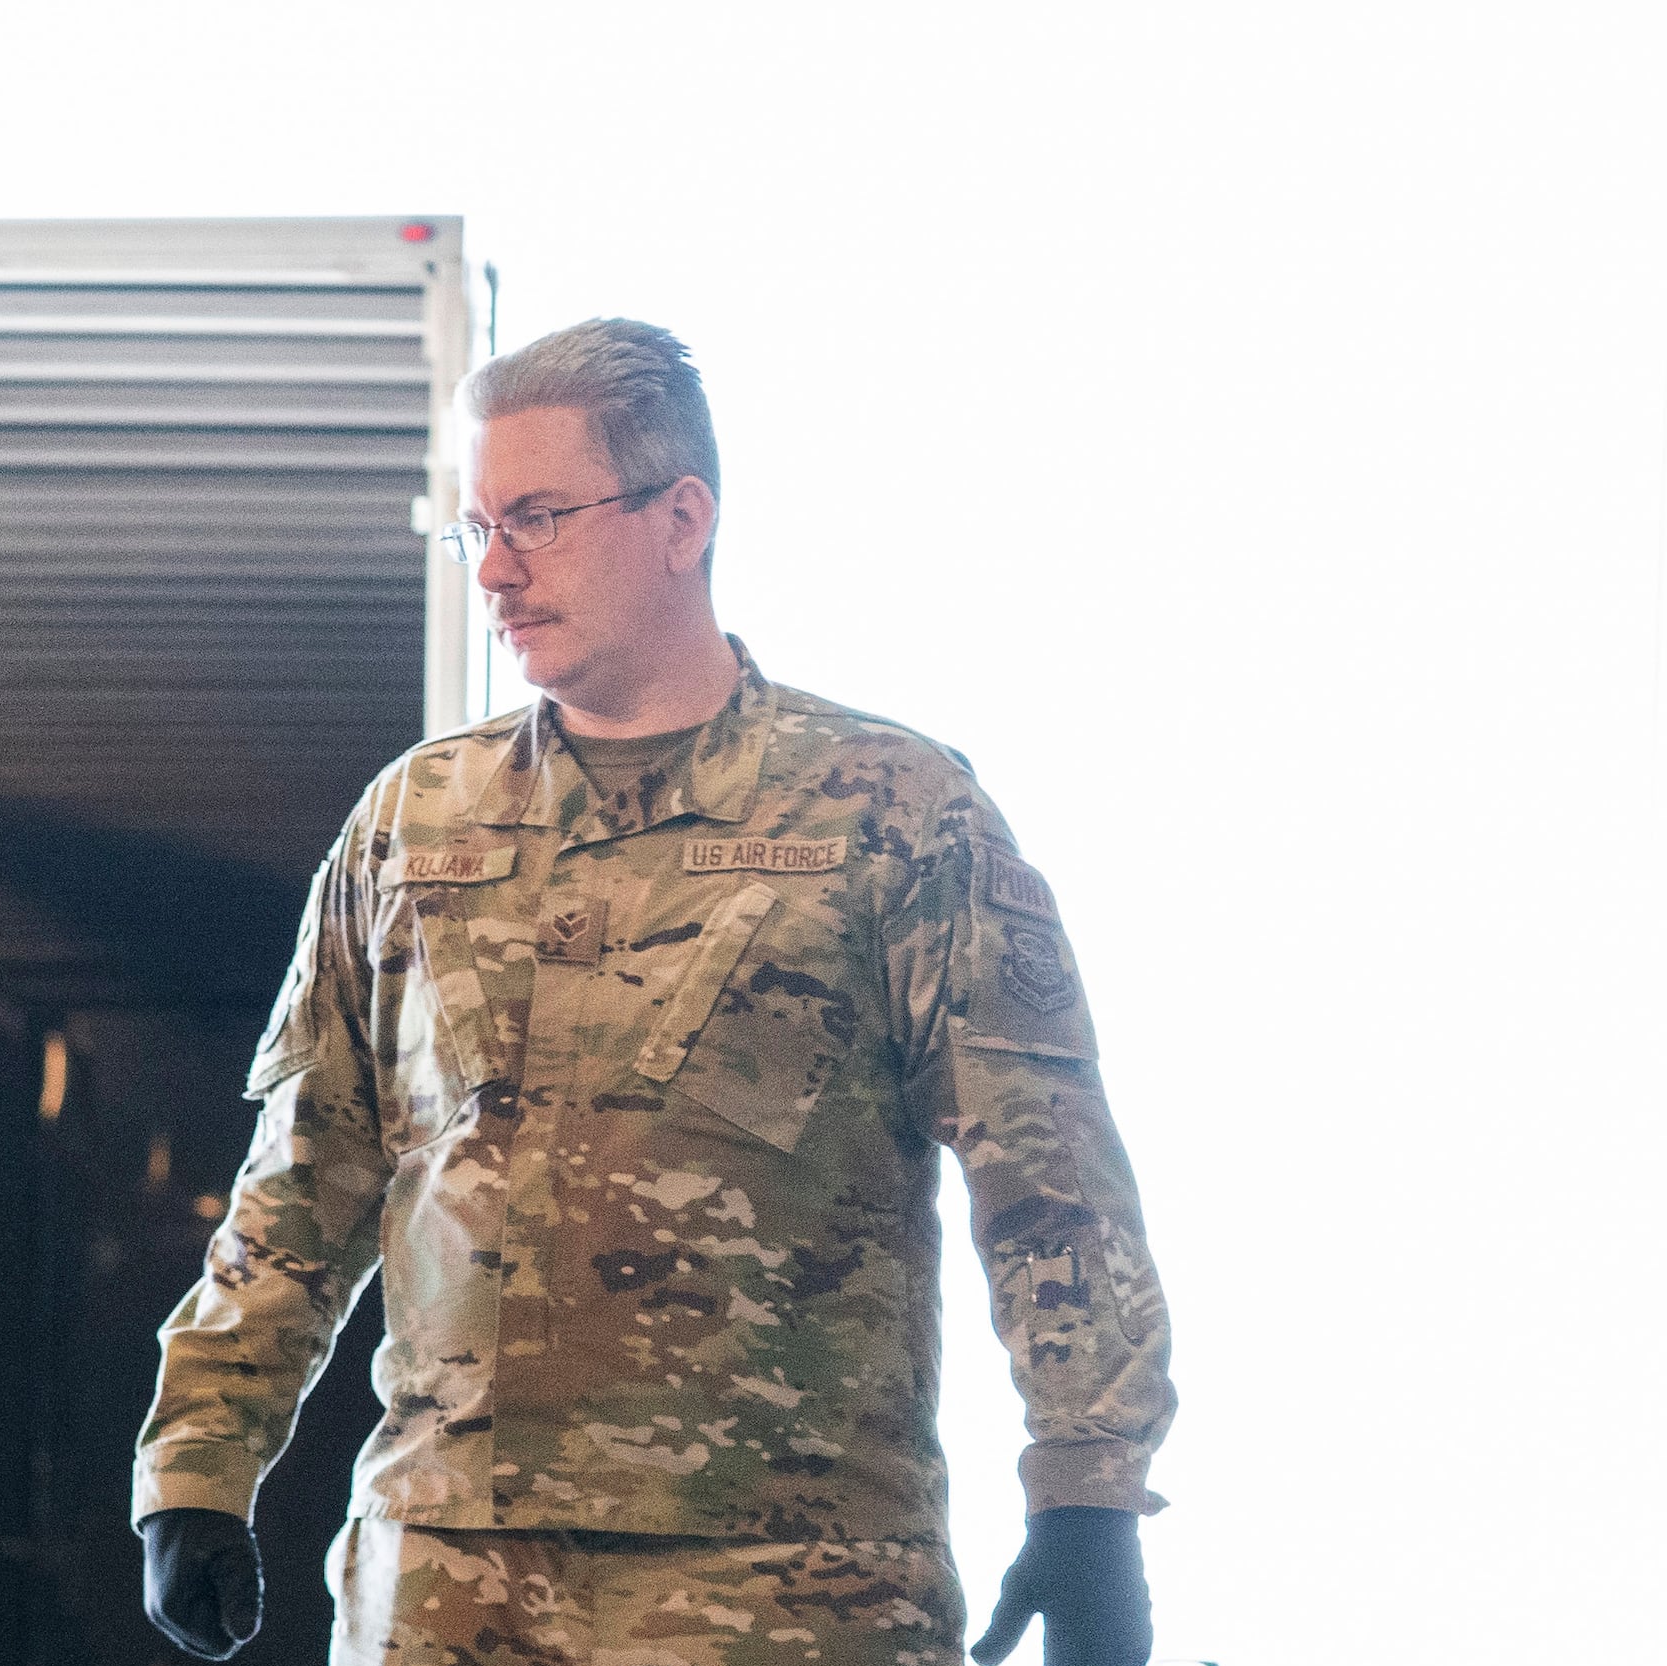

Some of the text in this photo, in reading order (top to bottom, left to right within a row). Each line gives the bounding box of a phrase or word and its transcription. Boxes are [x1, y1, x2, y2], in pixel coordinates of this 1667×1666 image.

[405, 854, 485, 877] KUJAWA
[692, 842, 839, 869] US AIR FORCE
